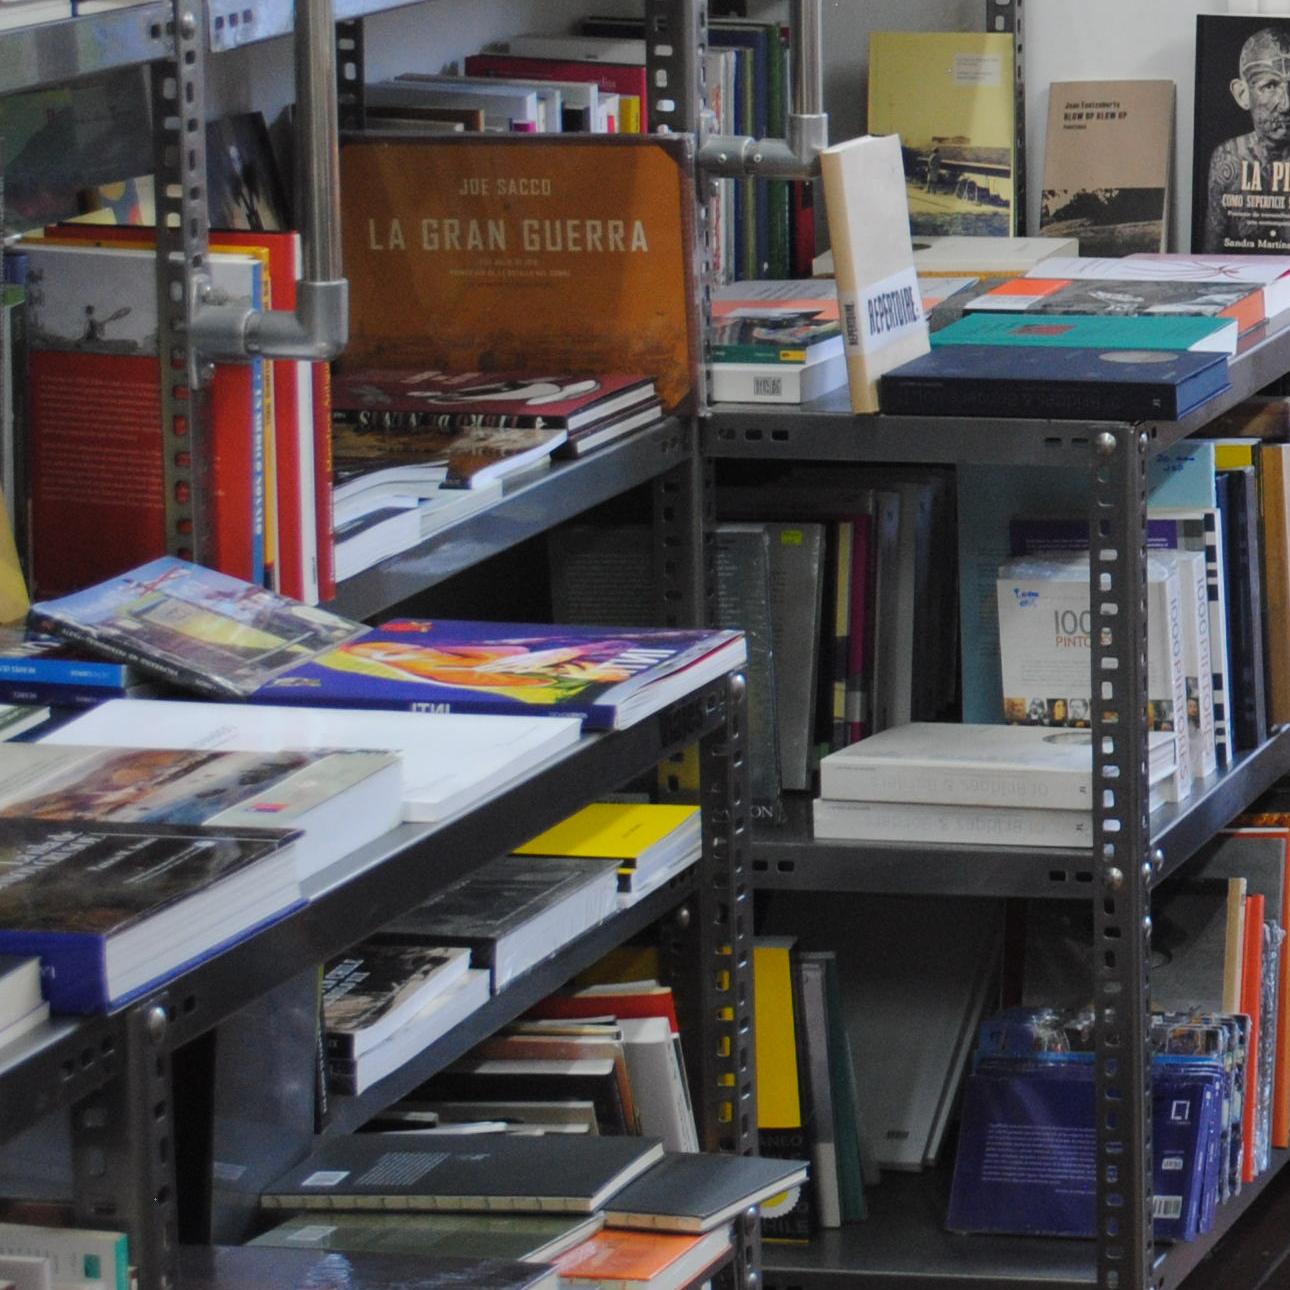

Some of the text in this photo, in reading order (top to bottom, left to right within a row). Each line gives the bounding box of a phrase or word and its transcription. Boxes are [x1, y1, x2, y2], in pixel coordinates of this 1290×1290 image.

[459, 177, 552, 197] JOE SACCO
[1241, 160, 1262, 192] LA
[1222, 193, 1244, 208] COMO
[1246, 194, 1286, 210] SUPERFICIE
[368, 217, 650, 253] LA GRAN GUERRA
[1224, 237, 1255, 249] Sandra
[1053, 609, 1093, 636] 100
